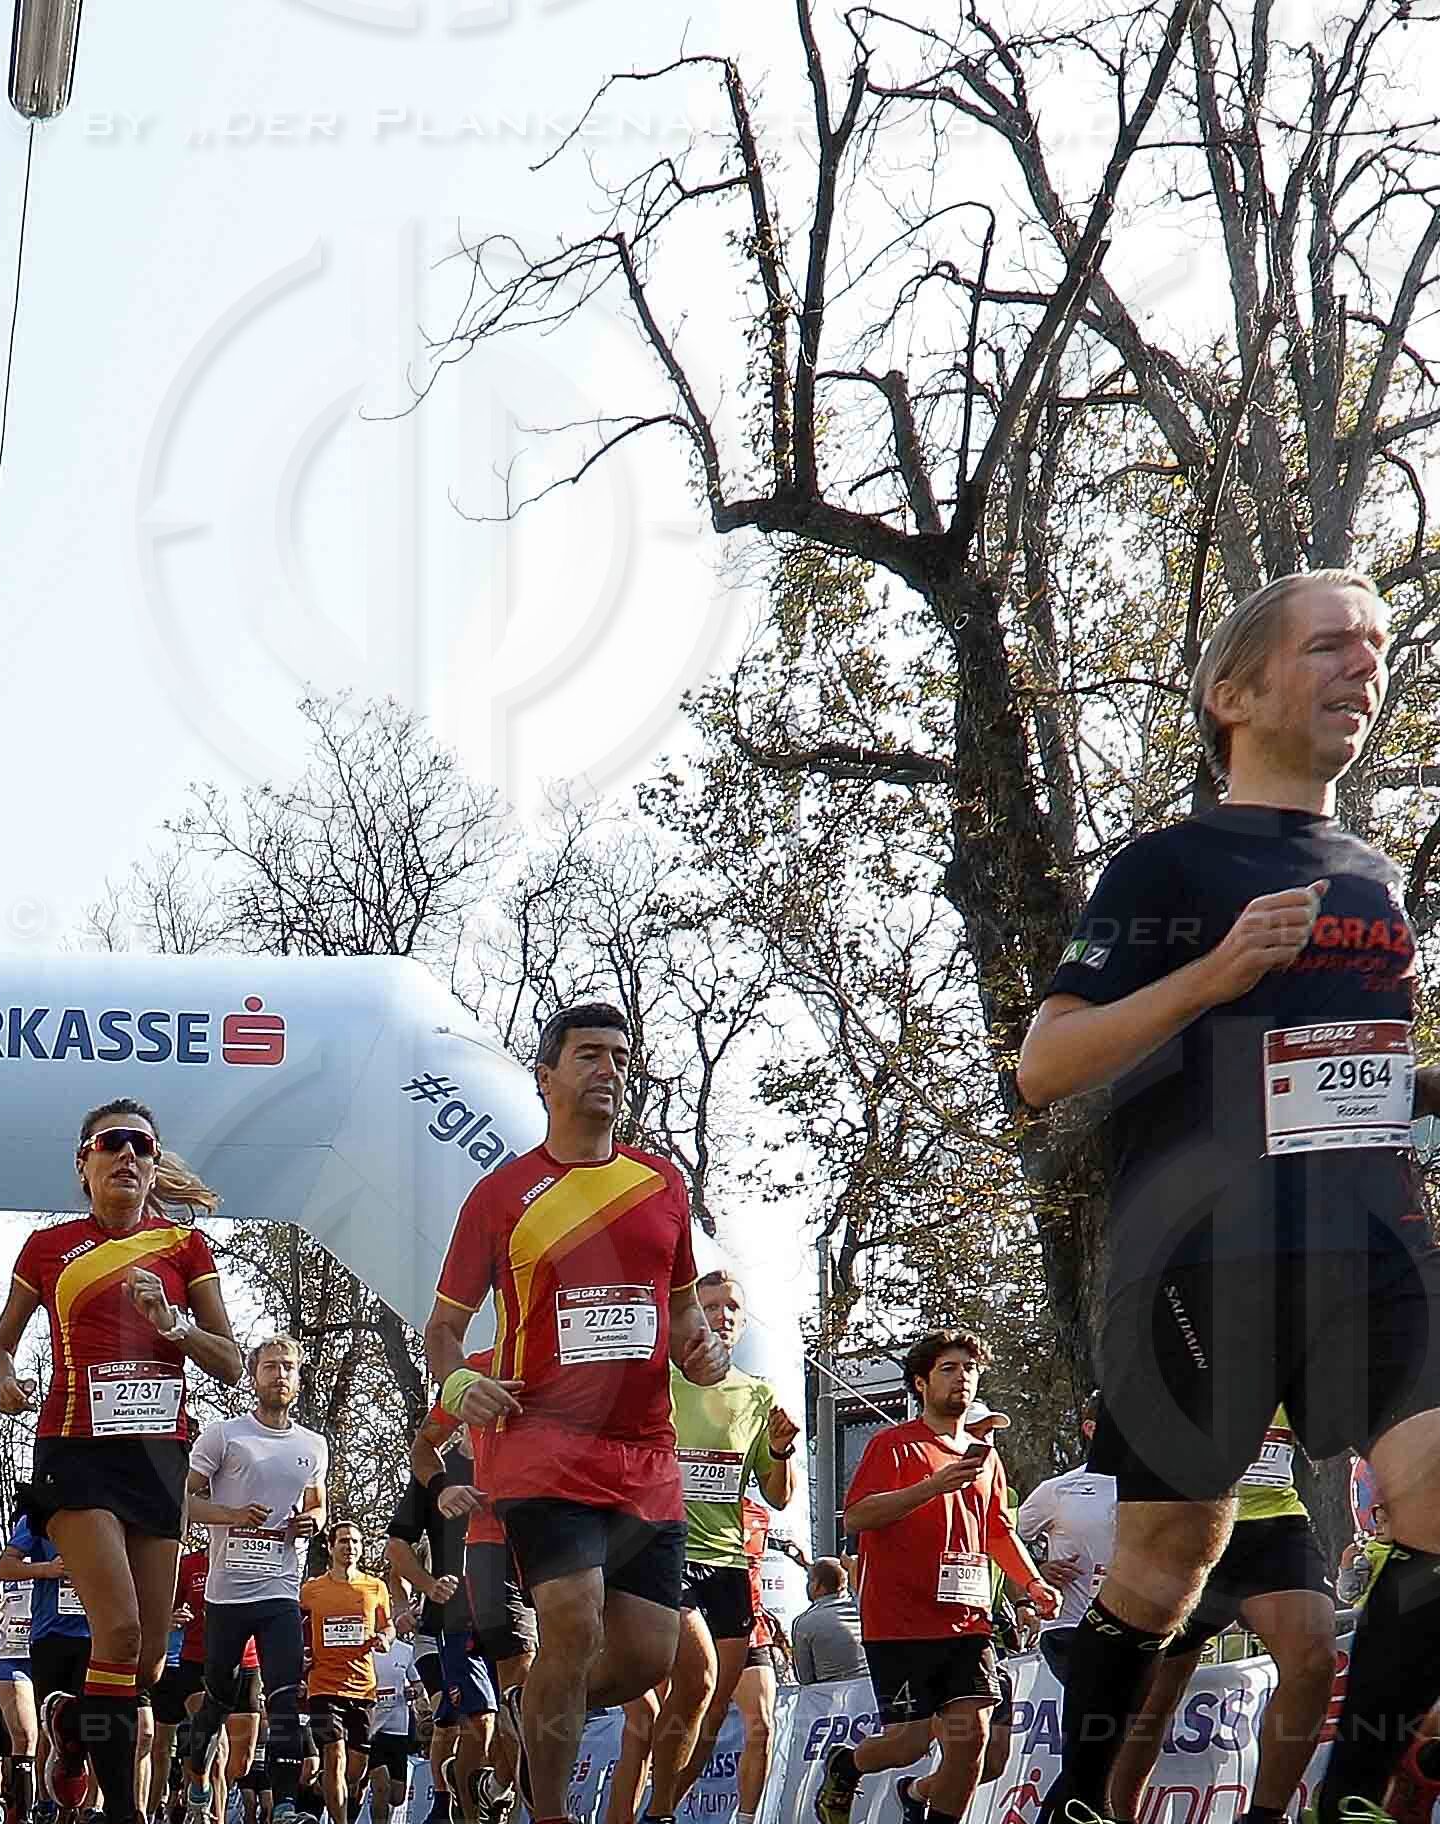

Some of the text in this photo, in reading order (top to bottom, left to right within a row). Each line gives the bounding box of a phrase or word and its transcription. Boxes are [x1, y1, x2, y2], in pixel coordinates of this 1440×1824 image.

[1313, 915, 1411, 951] GRAZ
[1316, 1058, 1392, 1092] 2964
[584, 1307, 635, 1328] 2725
[116, 1383, 162, 1401] 2737
[690, 1464, 726, 1479] 2708
[242, 1539, 272, 1552] 3394
